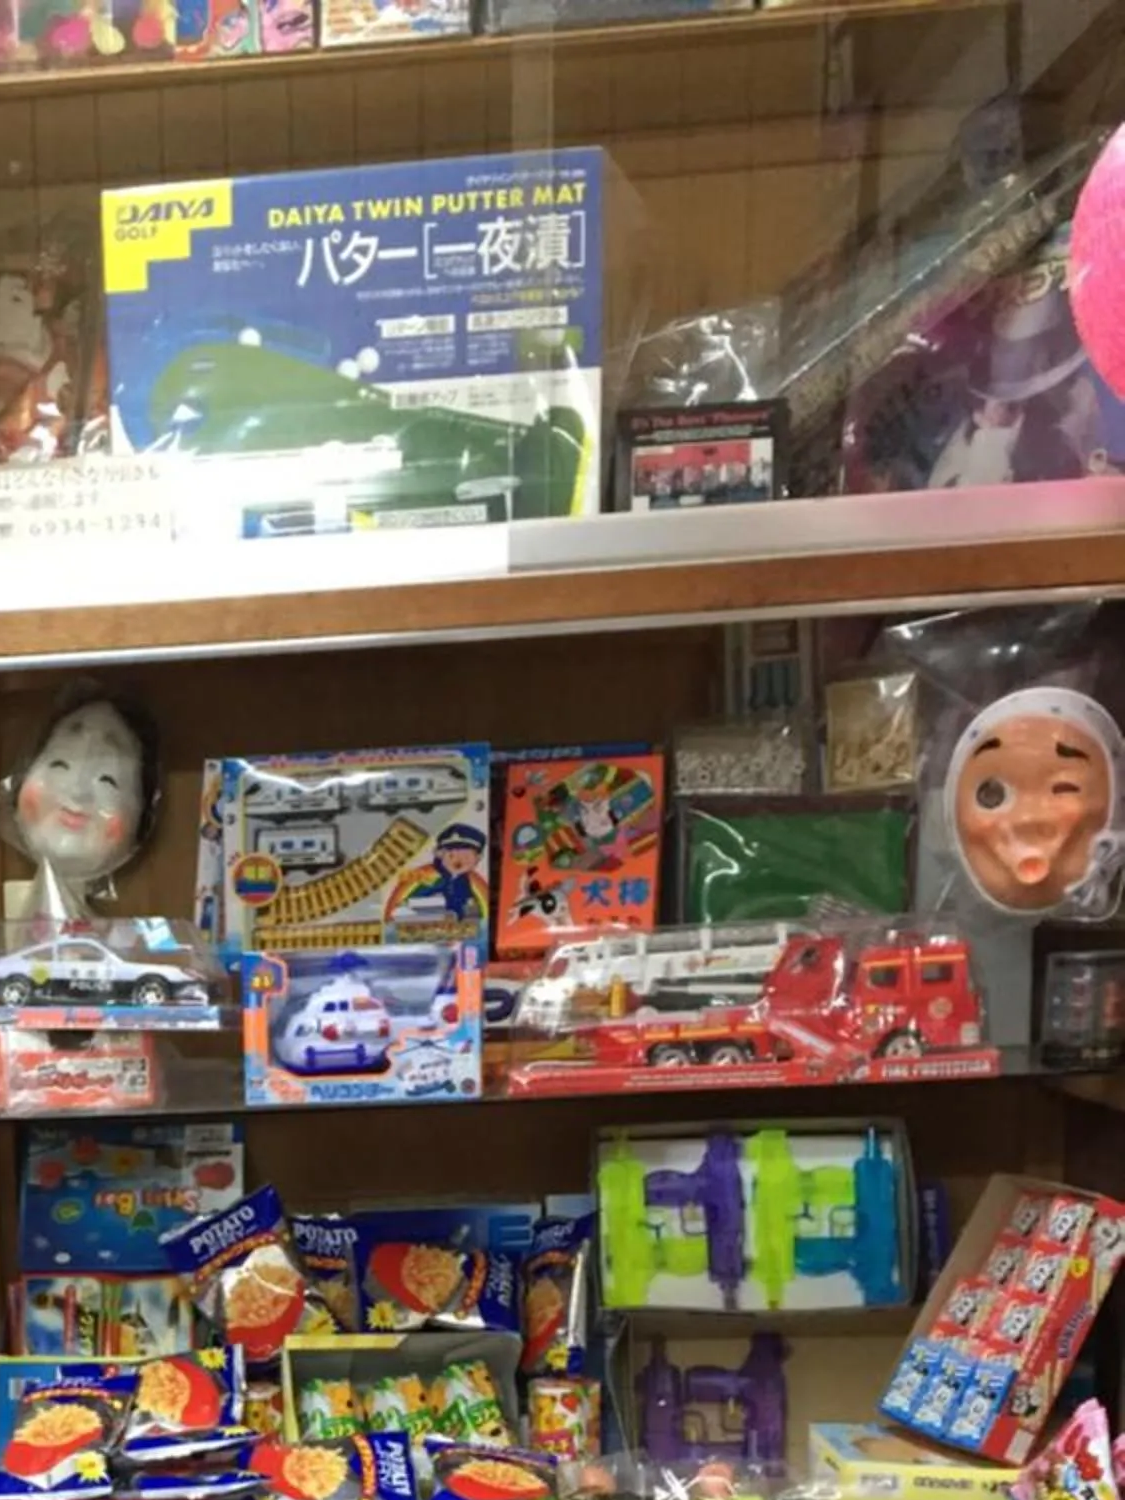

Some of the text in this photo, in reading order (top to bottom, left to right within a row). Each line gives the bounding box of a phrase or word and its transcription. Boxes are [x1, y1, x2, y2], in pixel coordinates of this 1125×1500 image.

[116, 197, 214, 224] DAIYA
[268, 182, 587, 229] DAIYA TWIN PUTTER MAT
[114, 226, 158, 242] GOLF
[28, 512, 162, 537] 6934-1234
[189, 1205, 255, 1255] POTATO
[293, 1222, 360, 1246] POTATO
